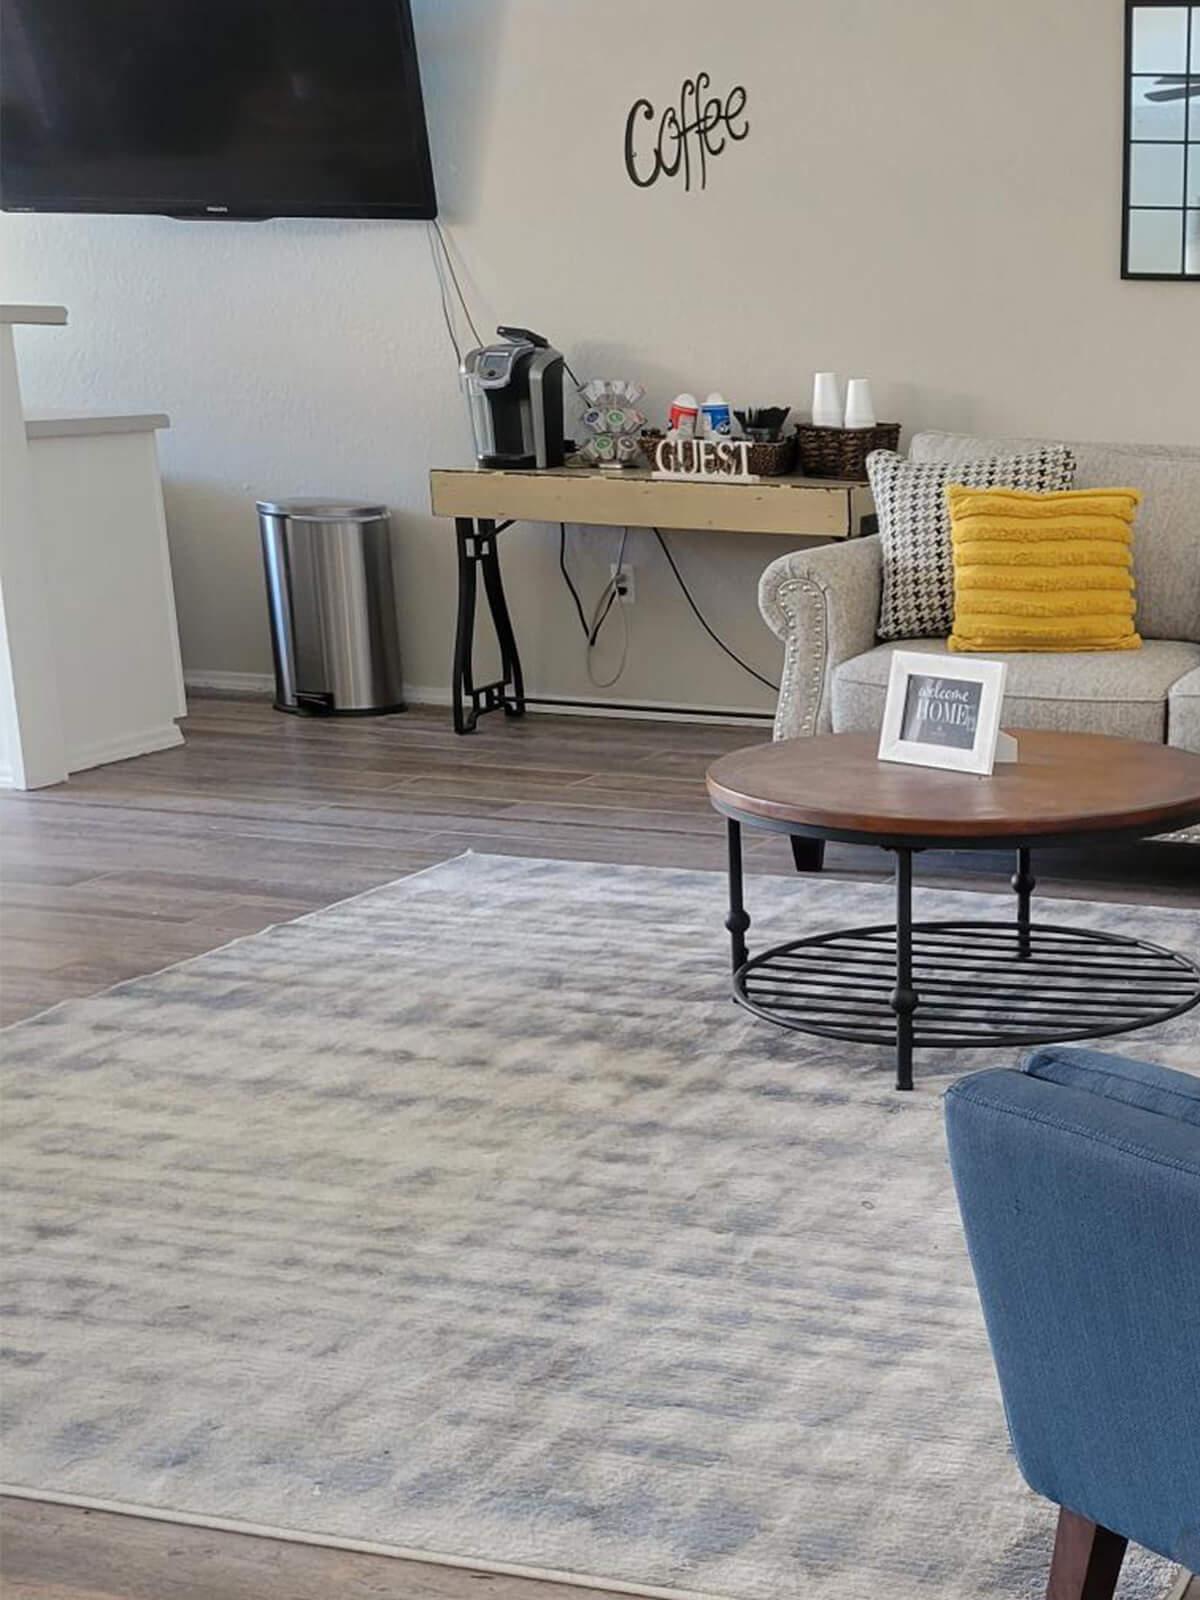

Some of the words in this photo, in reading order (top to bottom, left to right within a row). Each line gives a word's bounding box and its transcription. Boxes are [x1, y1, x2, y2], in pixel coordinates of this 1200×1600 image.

[625, 72, 749, 192] Coffee
[655, 439, 753, 477] GUEST
[918, 680, 969, 702] welcome
[916, 699, 969, 725] HOME
